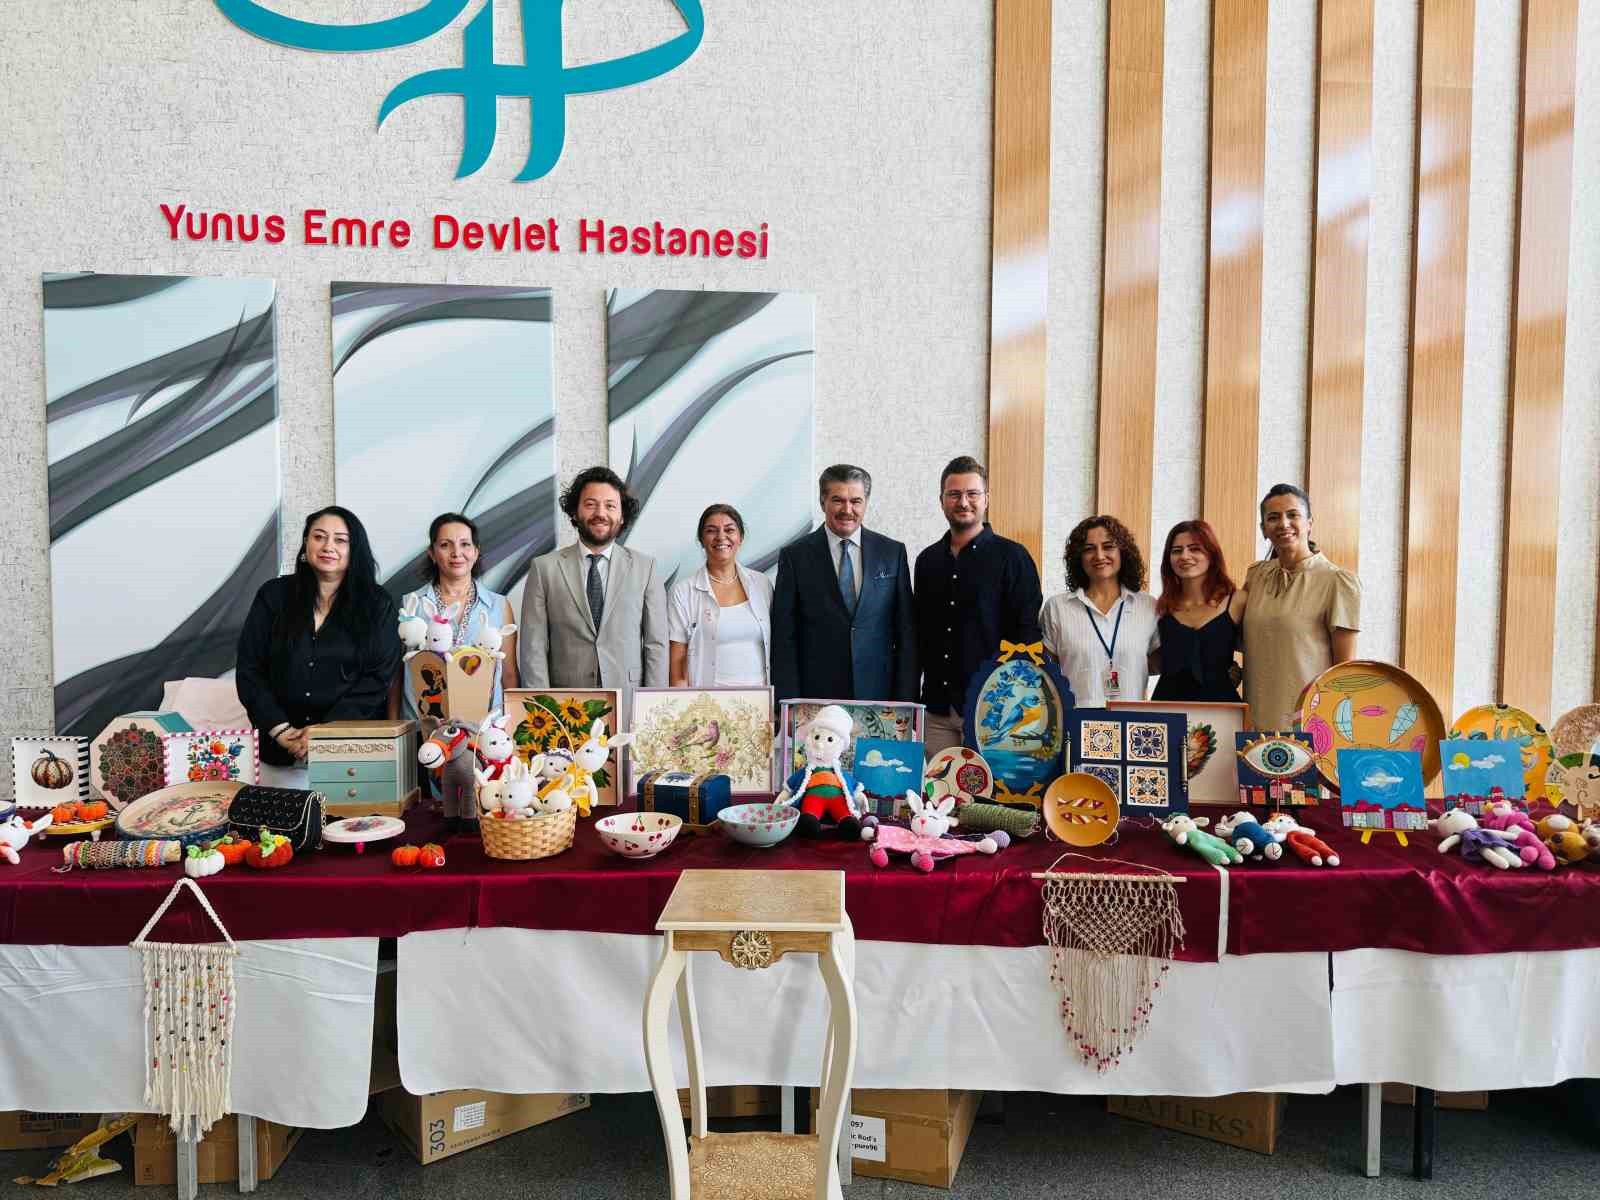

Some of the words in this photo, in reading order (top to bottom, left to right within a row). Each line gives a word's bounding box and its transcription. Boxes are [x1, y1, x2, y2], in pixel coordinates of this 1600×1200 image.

[159, 204, 285, 243] Yunus
[303, 209, 410, 247] Emre
[433, 214, 559, 251] Devlet
[579, 219, 768, 257] Hastanesi
[429, 1119, 445, 1155] 303
